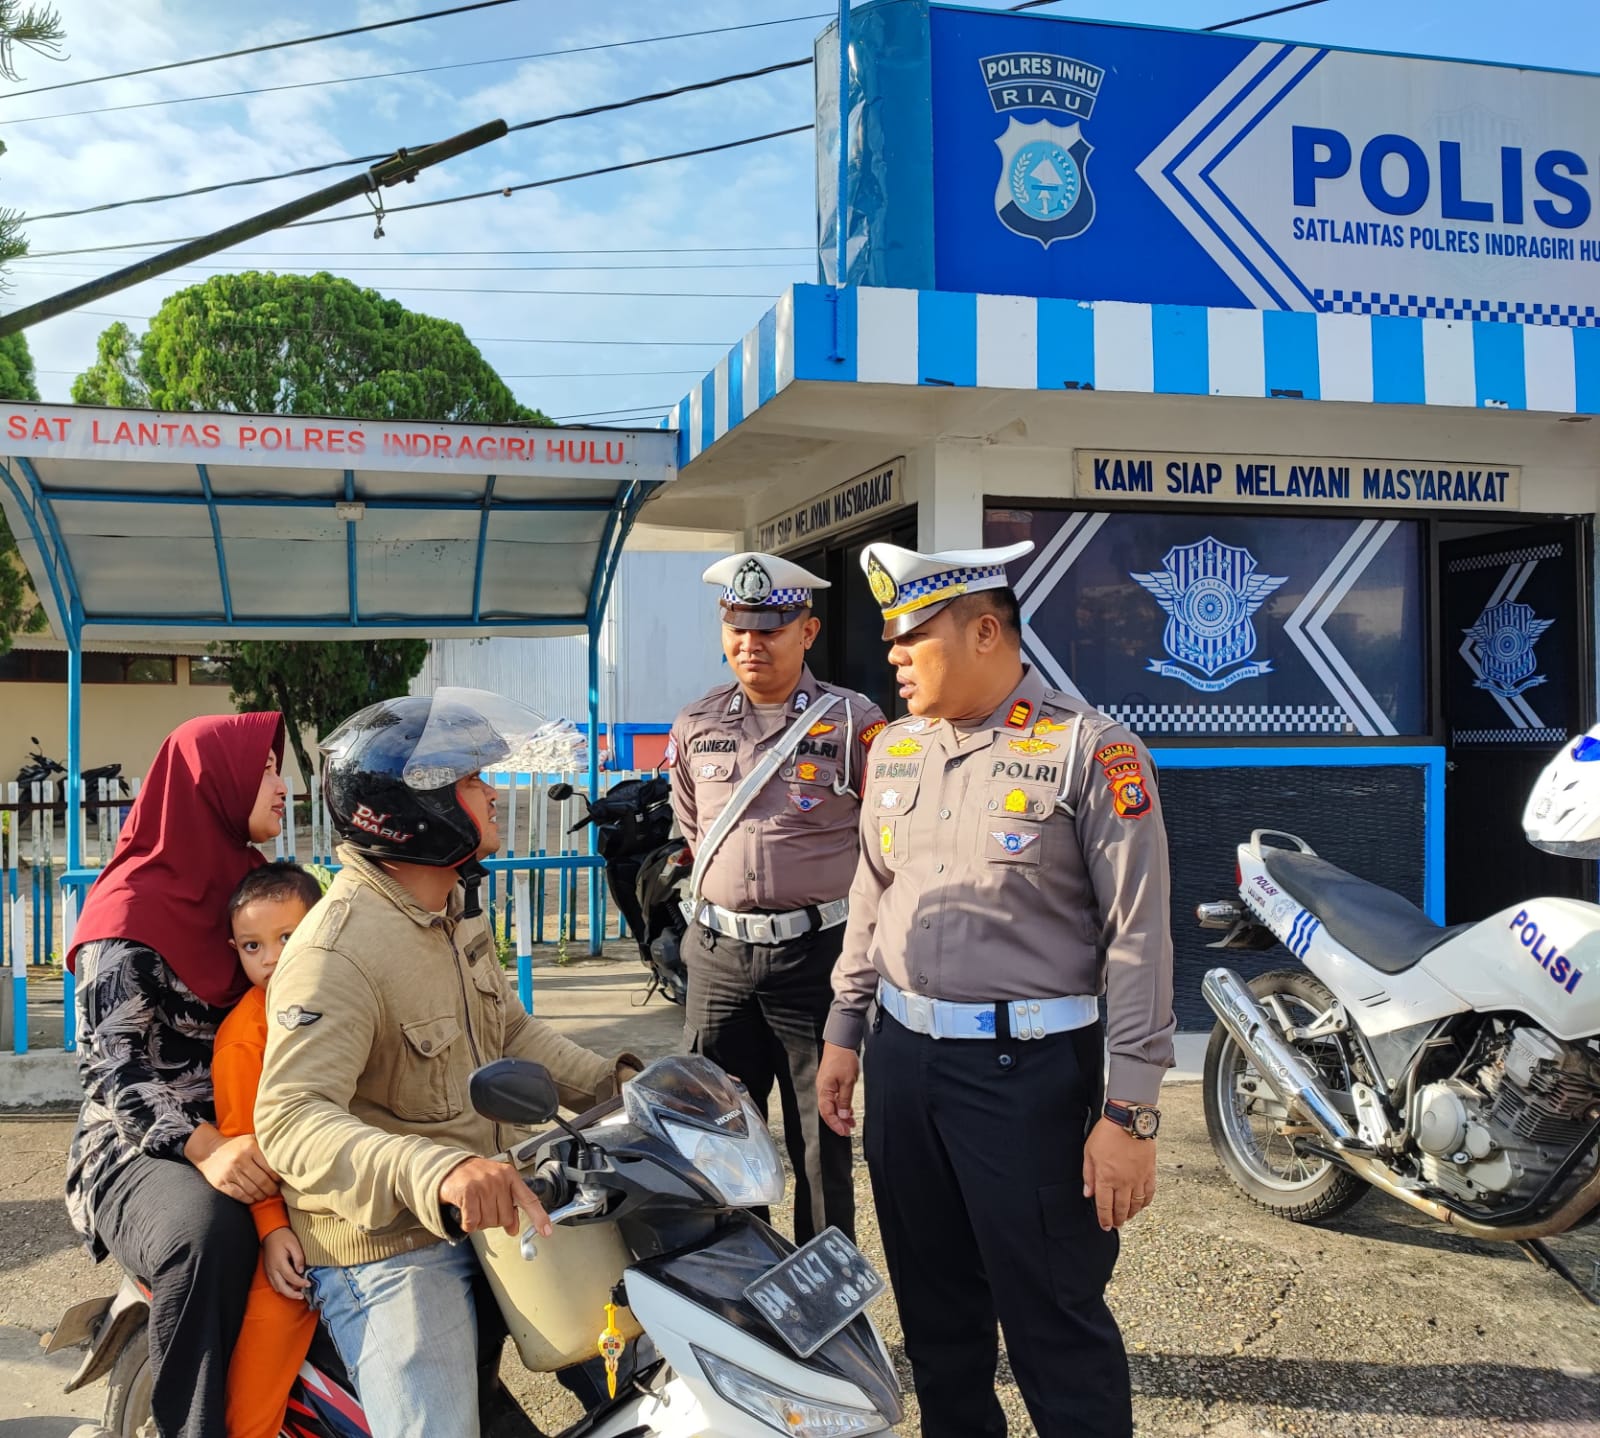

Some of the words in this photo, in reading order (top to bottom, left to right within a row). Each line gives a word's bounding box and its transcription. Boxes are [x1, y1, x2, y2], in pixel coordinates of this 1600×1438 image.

[987, 58, 1052, 80] POLRES
[1057, 61, 1099, 88] INHU
[1002, 88, 1081, 110] RIAU
[1292, 125, 1600, 230] POLIS
[1293, 216, 1404, 248] SATLANTAS
[1410, 226, 1480, 255] POLRES
[1485, 233, 1574, 261] INDRAGIRI
[7, 415, 72, 441] SAT
[92, 420, 221, 449] LANTAS
[239, 426, 366, 454] POLRES
[383, 432, 535, 462] INDRAGIRI
[546, 438, 624, 465] HULU
[1093, 458, 1153, 492] KAMI
[1166, 461, 1222, 494] SIAP
[1236, 463, 1350, 499] MELAYANI
[1363, 468, 1510, 502] MASYARAKAT
[795, 498, 831, 538] MELAYANI
[834, 470, 894, 522] MASYARAKAT
[1194, 581, 1226, 591] POLISI
[692, 739, 737, 754] KANEZA
[796, 740, 839, 759] OLRI
[991, 761, 1058, 783] POLRI
[1109, 763, 1138, 776] RIAU
[357, 803, 388, 823] DJ
[1252, 875, 1280, 897] POLISI
[1509, 908, 1583, 995] POLISI
[714, 1109, 743, 1126] HONDA
[754, 1282, 796, 1320] BM
